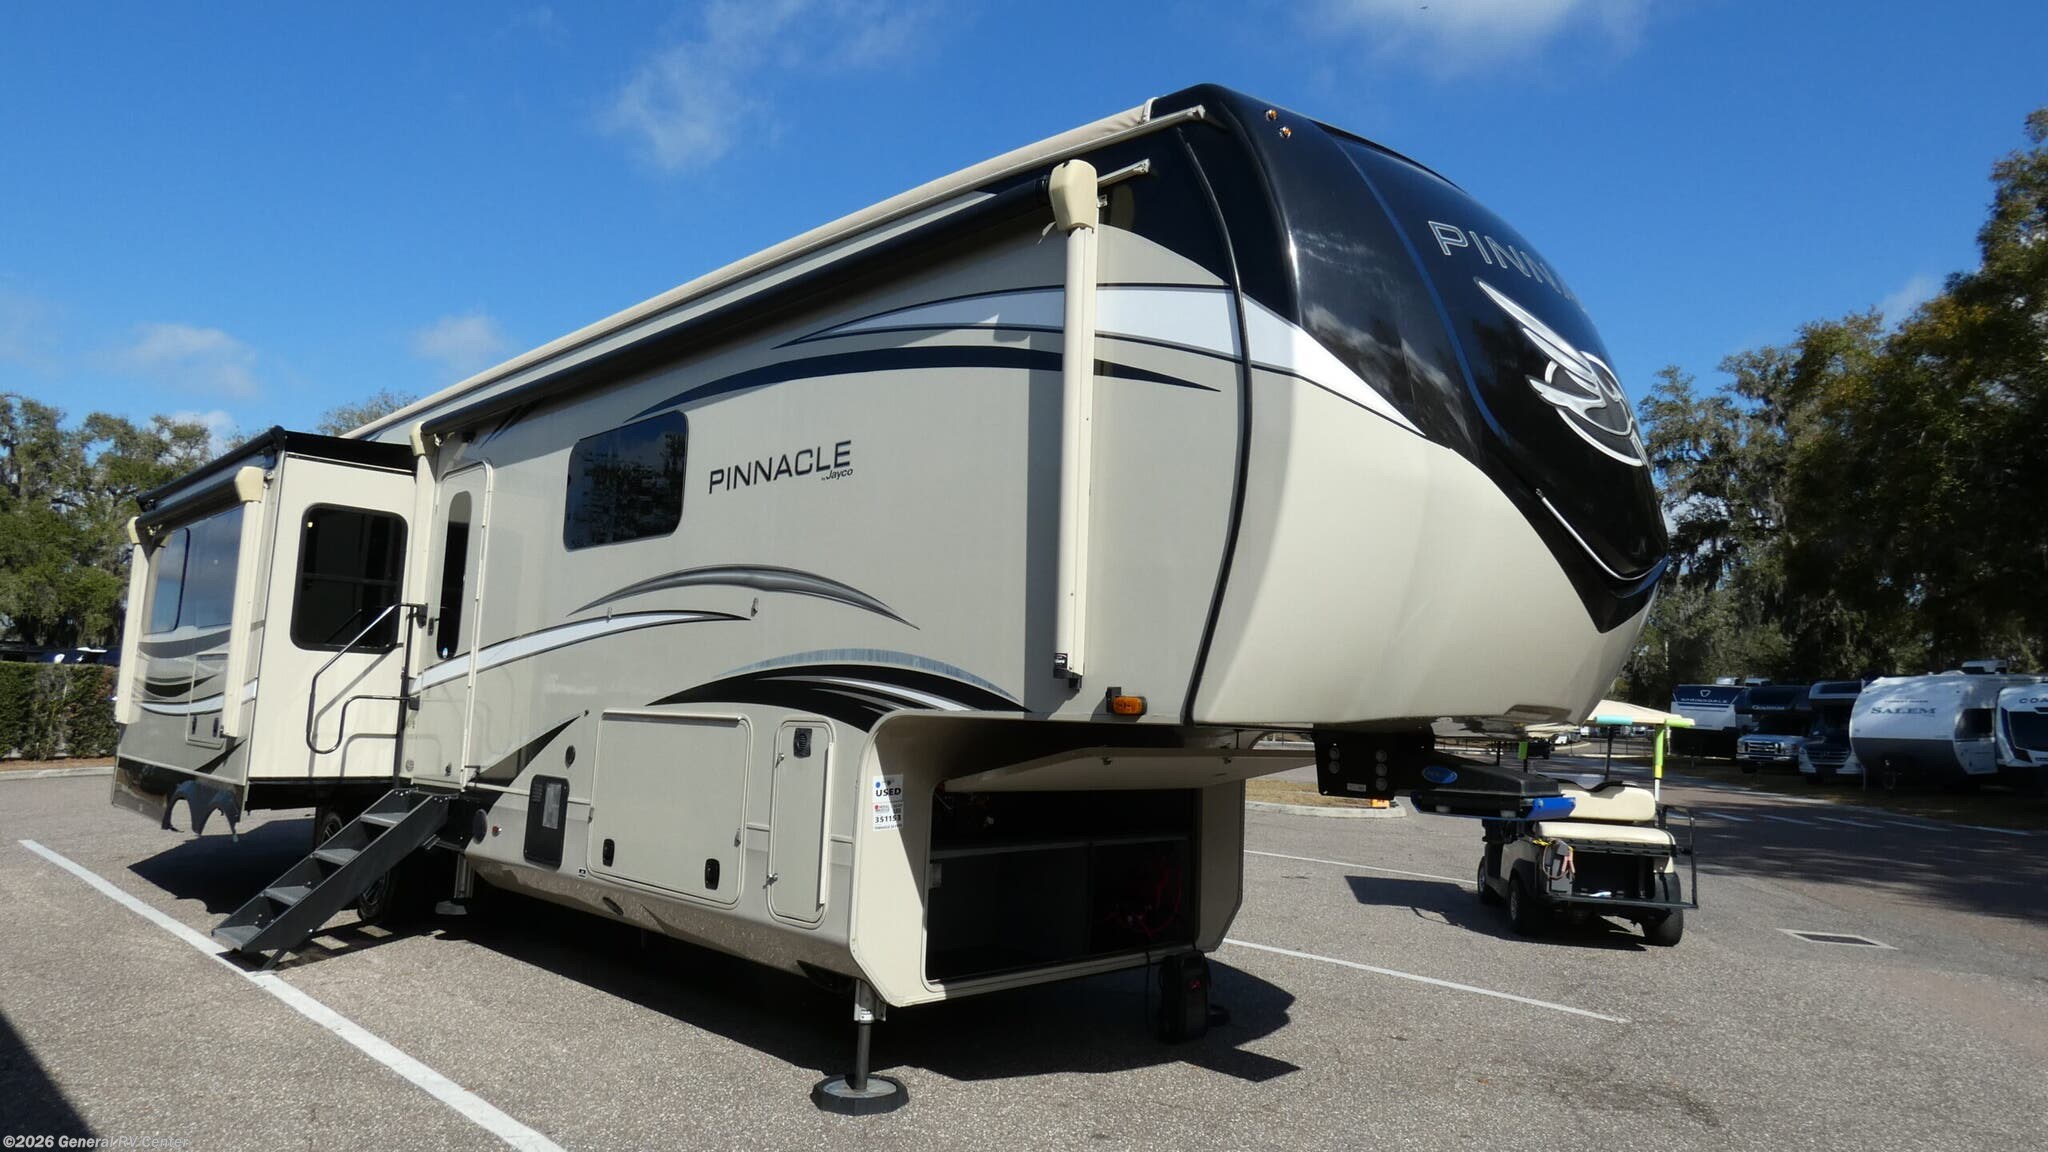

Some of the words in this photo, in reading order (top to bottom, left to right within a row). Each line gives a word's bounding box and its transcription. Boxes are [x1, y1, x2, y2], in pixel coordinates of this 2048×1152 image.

[709, 440, 851, 494] PINNACLE
[825, 468, 854, 481] Jayco
[1871, 707, 1937, 715] SALEM
[875, 787, 902, 797] USED
